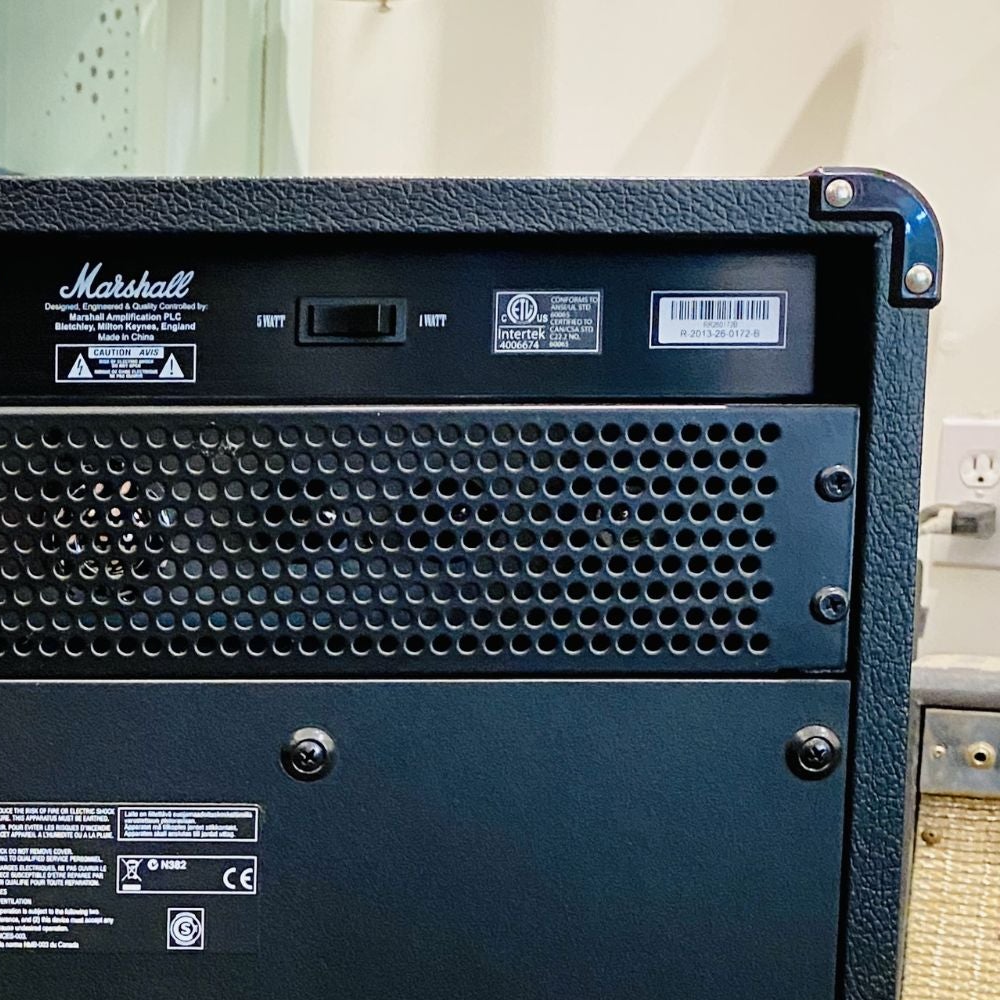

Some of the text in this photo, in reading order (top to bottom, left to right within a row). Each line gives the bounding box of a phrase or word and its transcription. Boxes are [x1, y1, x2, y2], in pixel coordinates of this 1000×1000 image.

[59, 262, 195, 299] Marshall
[83, 303, 124, 312] Engineered
[132, 303, 158, 312] Quality
[159, 303, 196, 312] Controlled
[69, 313, 182, 321] Marshall Amplification PLC
[256, 314, 286, 328] 5 WATT
[424, 314, 447, 327] WATT
[98, 322, 124, 331] Milton
[126, 322, 159, 331] Keynes,
[160, 322, 196, 331] England
[98, 333, 120, 341] Made
[130, 333, 154, 341] China
[498, 327, 546, 340] Intertek
[500, 340, 539, 349] 4006674
[160, 860, 187, 870] N382
[222, 867, 254, 890] CE
